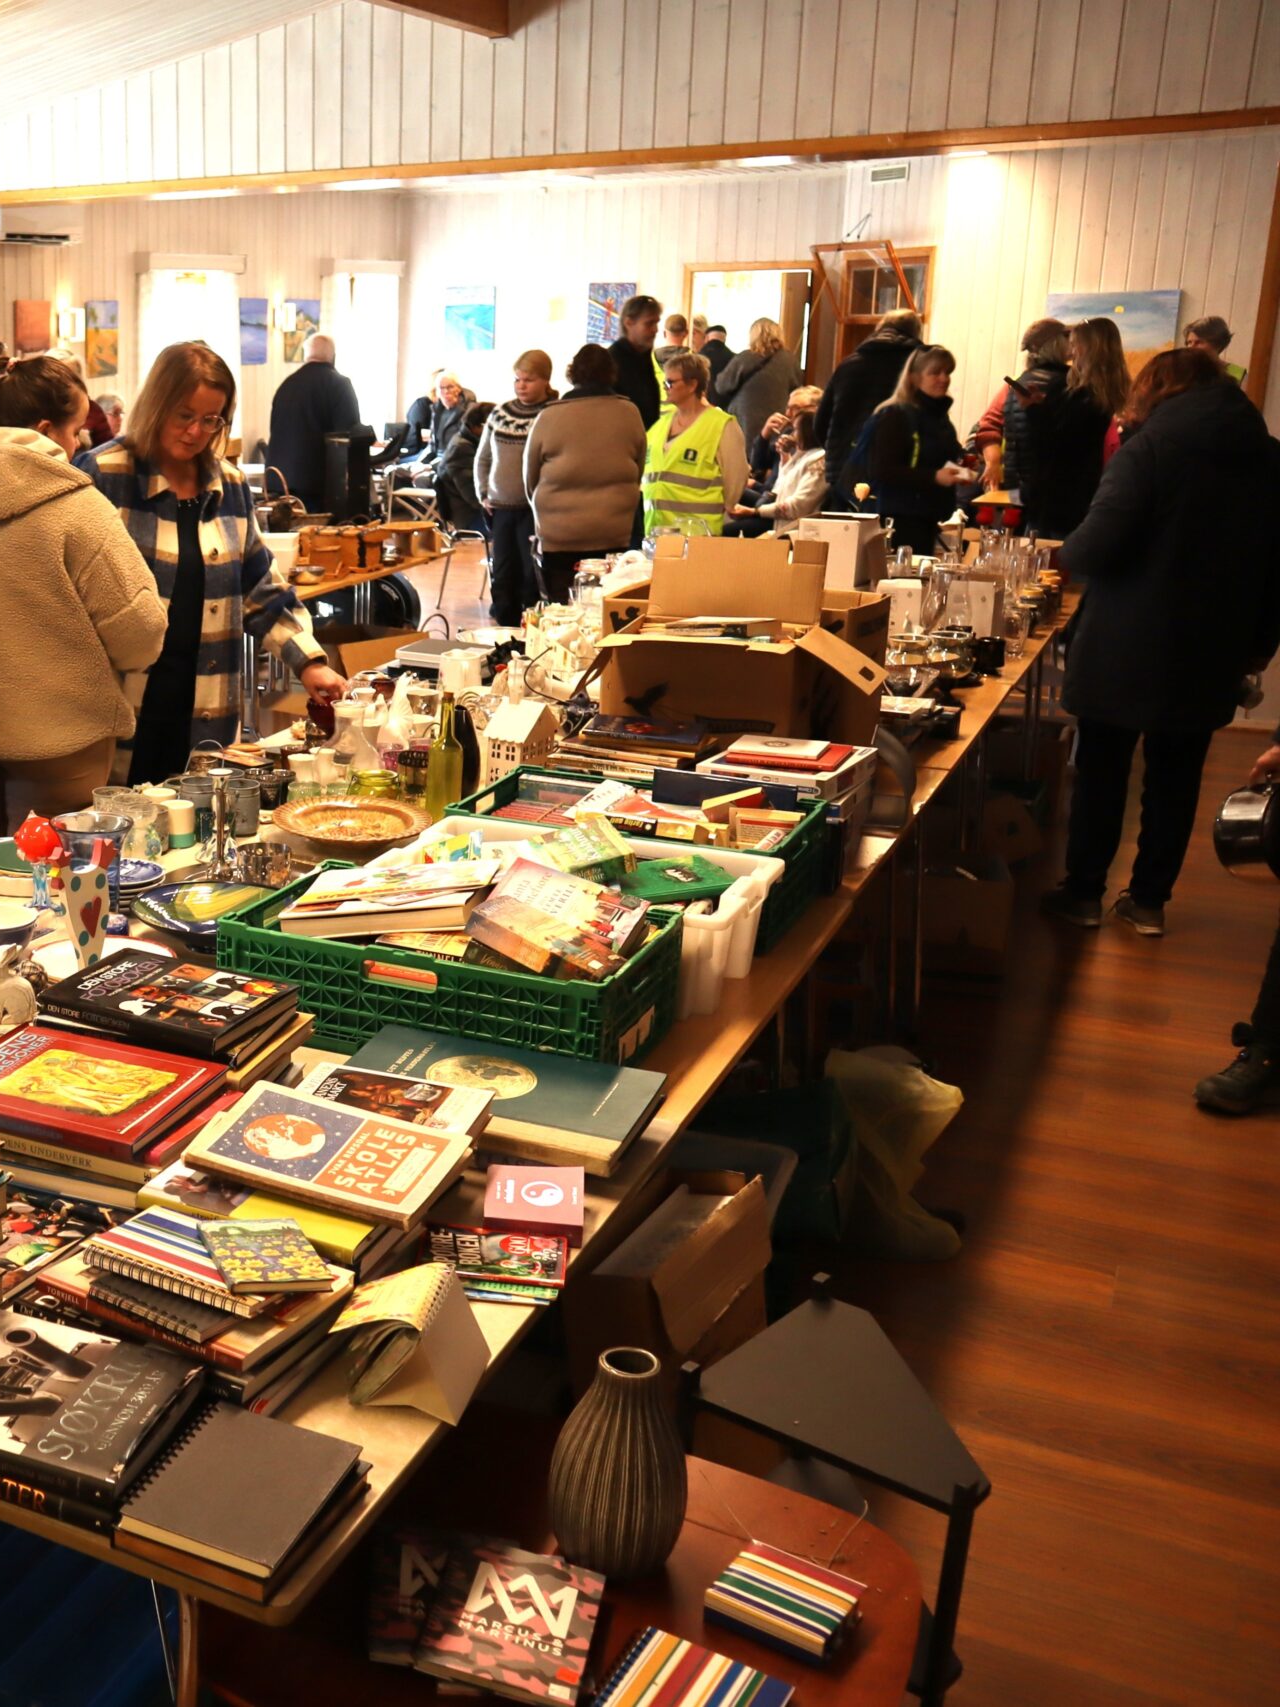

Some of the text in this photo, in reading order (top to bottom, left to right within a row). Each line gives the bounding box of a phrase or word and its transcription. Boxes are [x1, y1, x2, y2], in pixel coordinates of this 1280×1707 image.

[77, 975, 104, 991] DEN
[100, 960, 138, 984] STORE
[79, 958, 168, 1002] FOTOBOKEN
[47, 1004, 61, 1014] DEN
[61, 1007, 81, 1019] STORE
[29, 1144, 94, 1168] UNDERVERK
[333, 1127, 397, 1187] SKOLE
[355, 1133, 418, 1195] ATLAS
[429, 1228, 456, 1266] PØRRE-
[455, 1233, 482, 1265] BOKEN
[47, 1286, 80, 1306] TORKJELL
[37, 1346, 152, 1461] SJØKRIG
[458, 1620, 563, 1657] MARTINUS
[460, 1611, 564, 1648] MARCUS &
